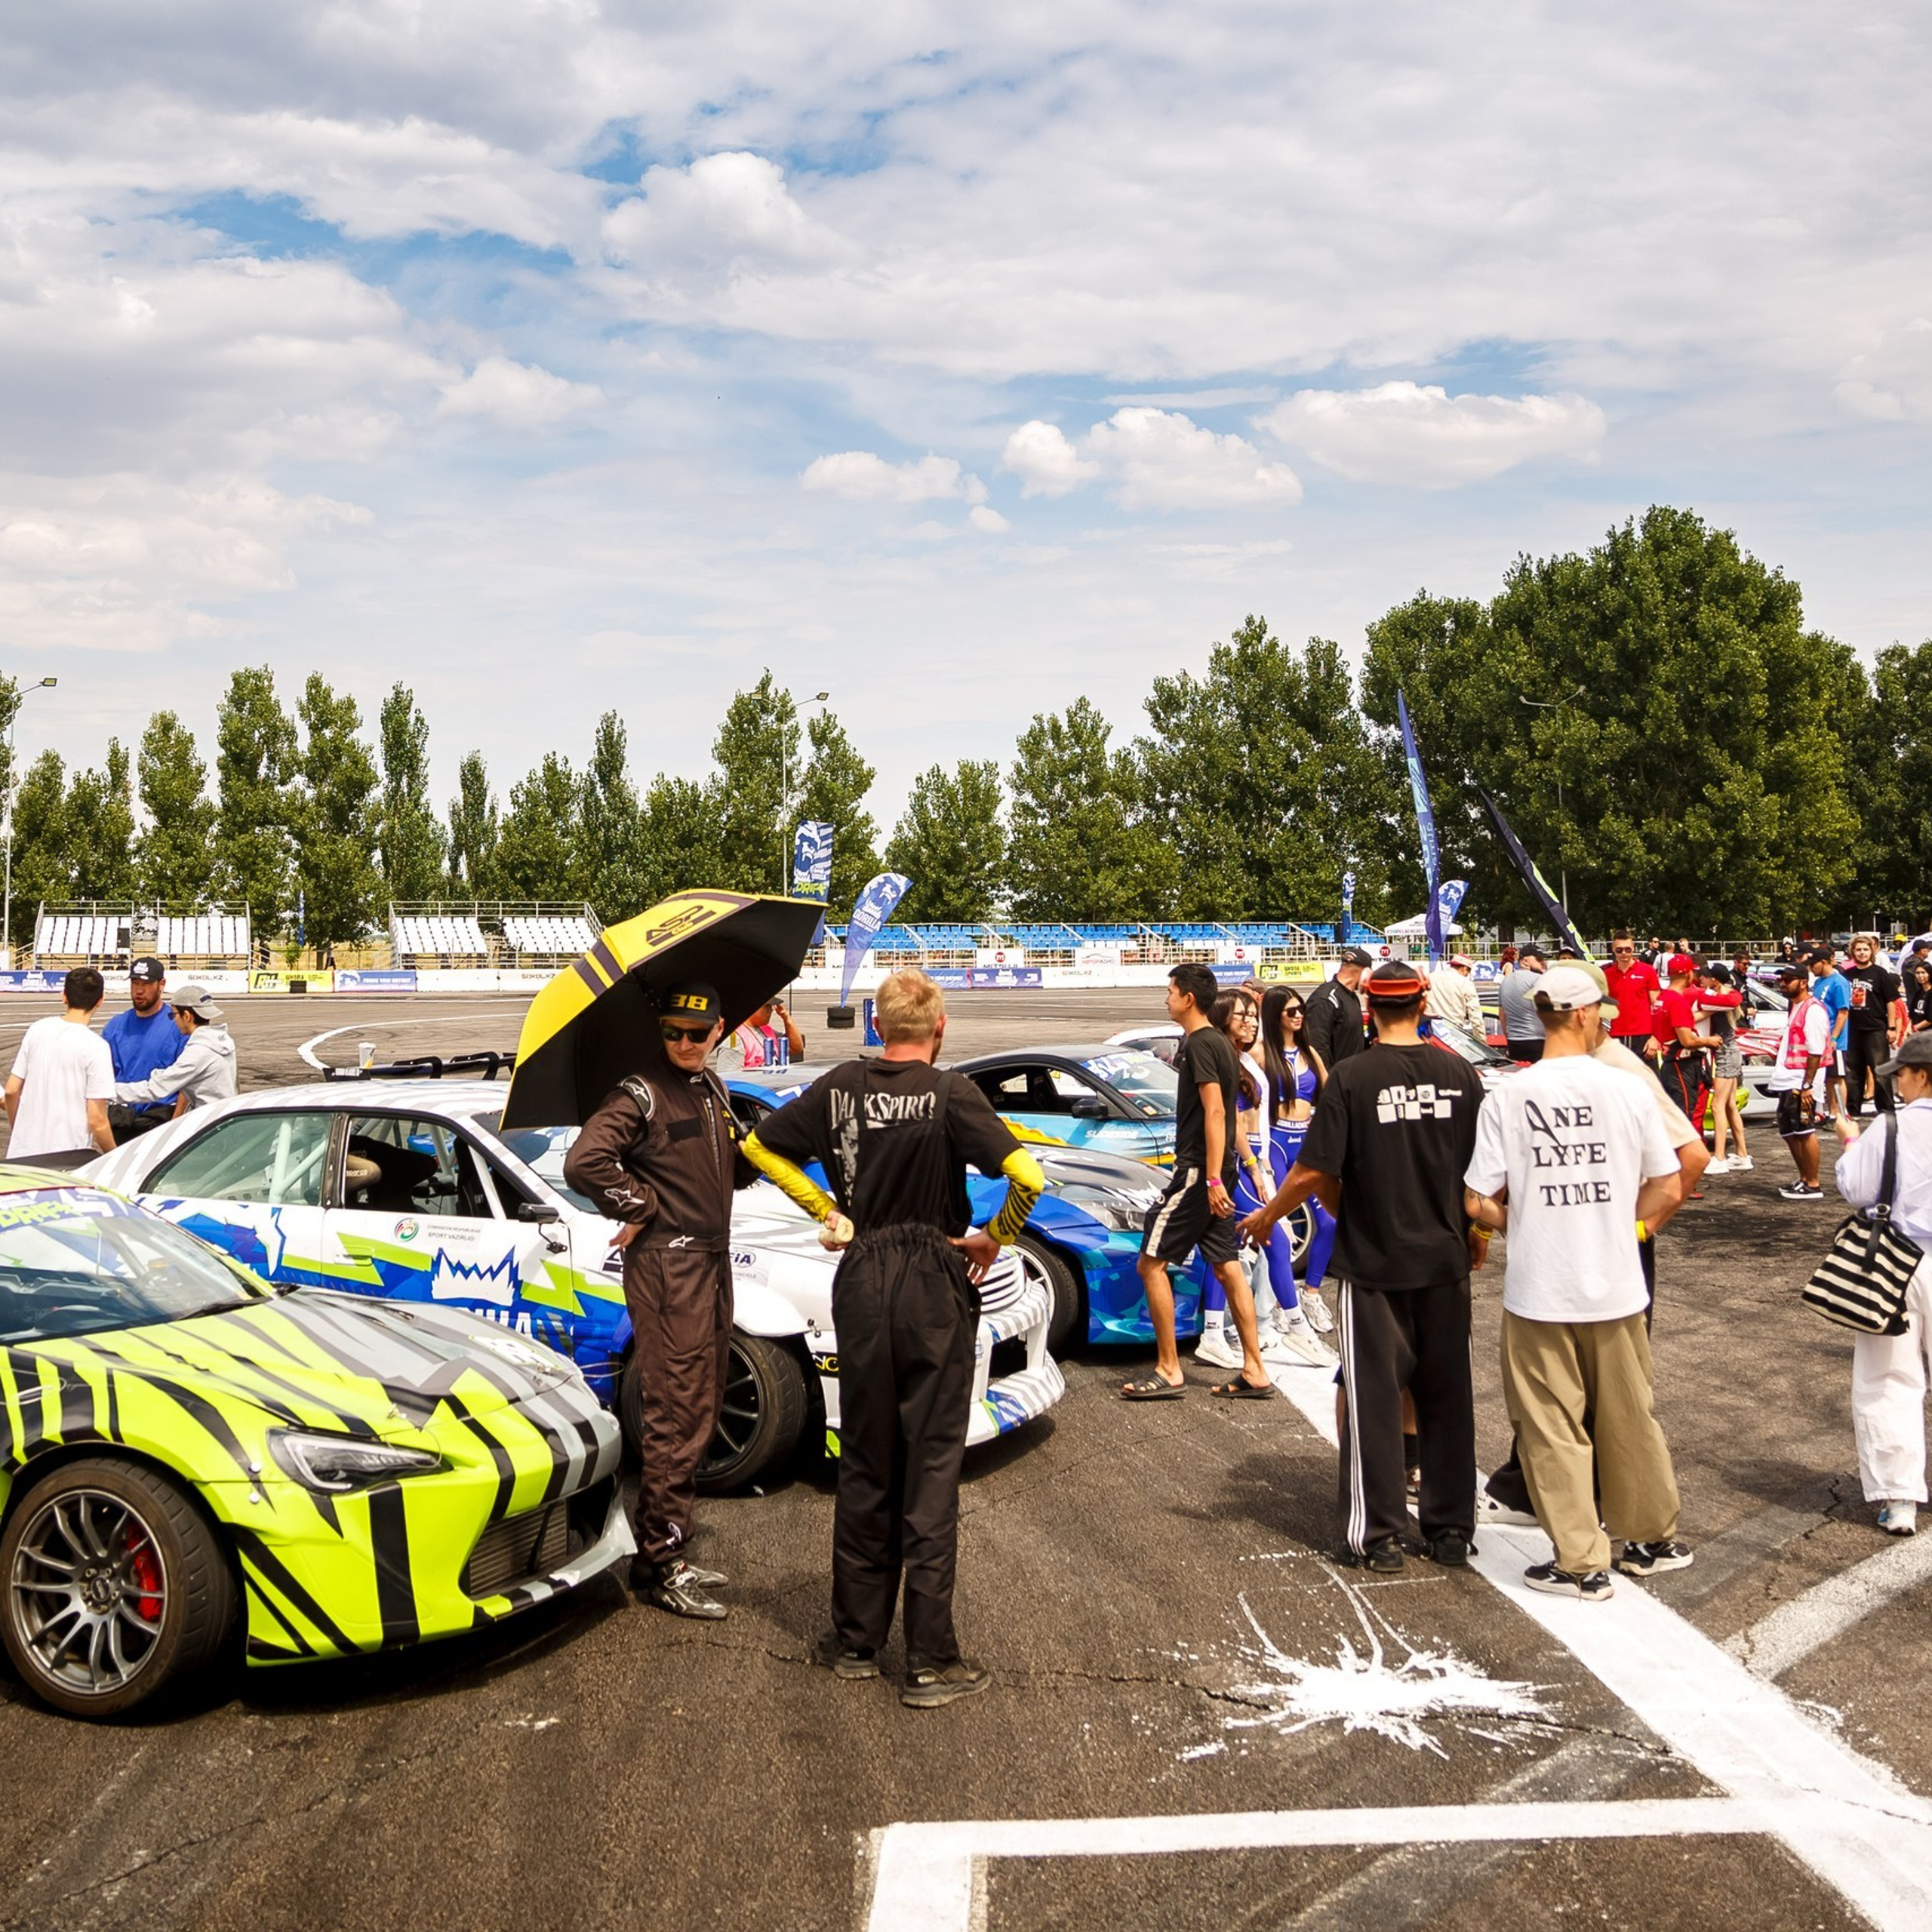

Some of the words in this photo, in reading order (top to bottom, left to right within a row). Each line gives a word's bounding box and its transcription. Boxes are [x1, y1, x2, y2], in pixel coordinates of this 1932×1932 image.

[852, 909, 882, 932] GORILLA
[670, 994, 709, 1011] 38
[1531, 1142, 1607, 1168] LYFE
[1540, 1180, 1612, 1208] TIME
